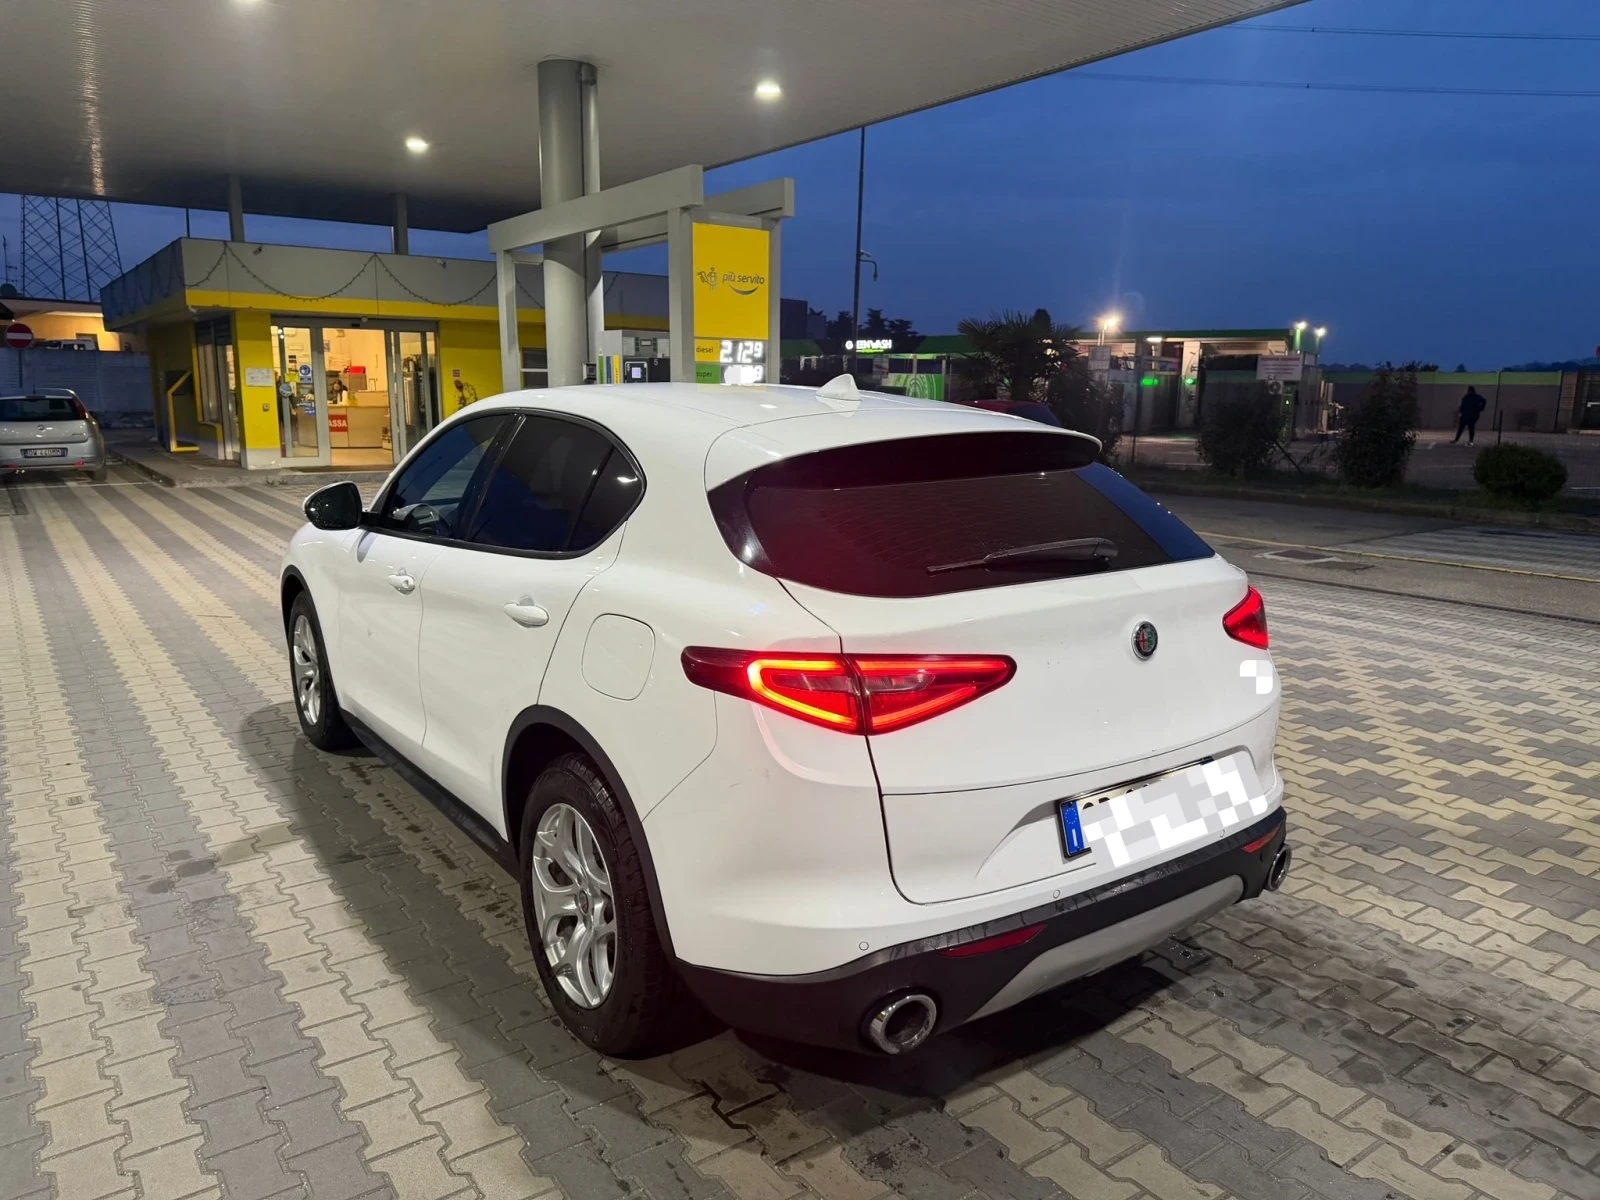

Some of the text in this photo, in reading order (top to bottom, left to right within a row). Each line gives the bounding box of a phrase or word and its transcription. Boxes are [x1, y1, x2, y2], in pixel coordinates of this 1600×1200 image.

[722, 271, 765, 285] più servito
[845, 338, 892, 350] GEENWASH
[695, 346, 714, 354] diesel
[695, 371, 713, 379] super
